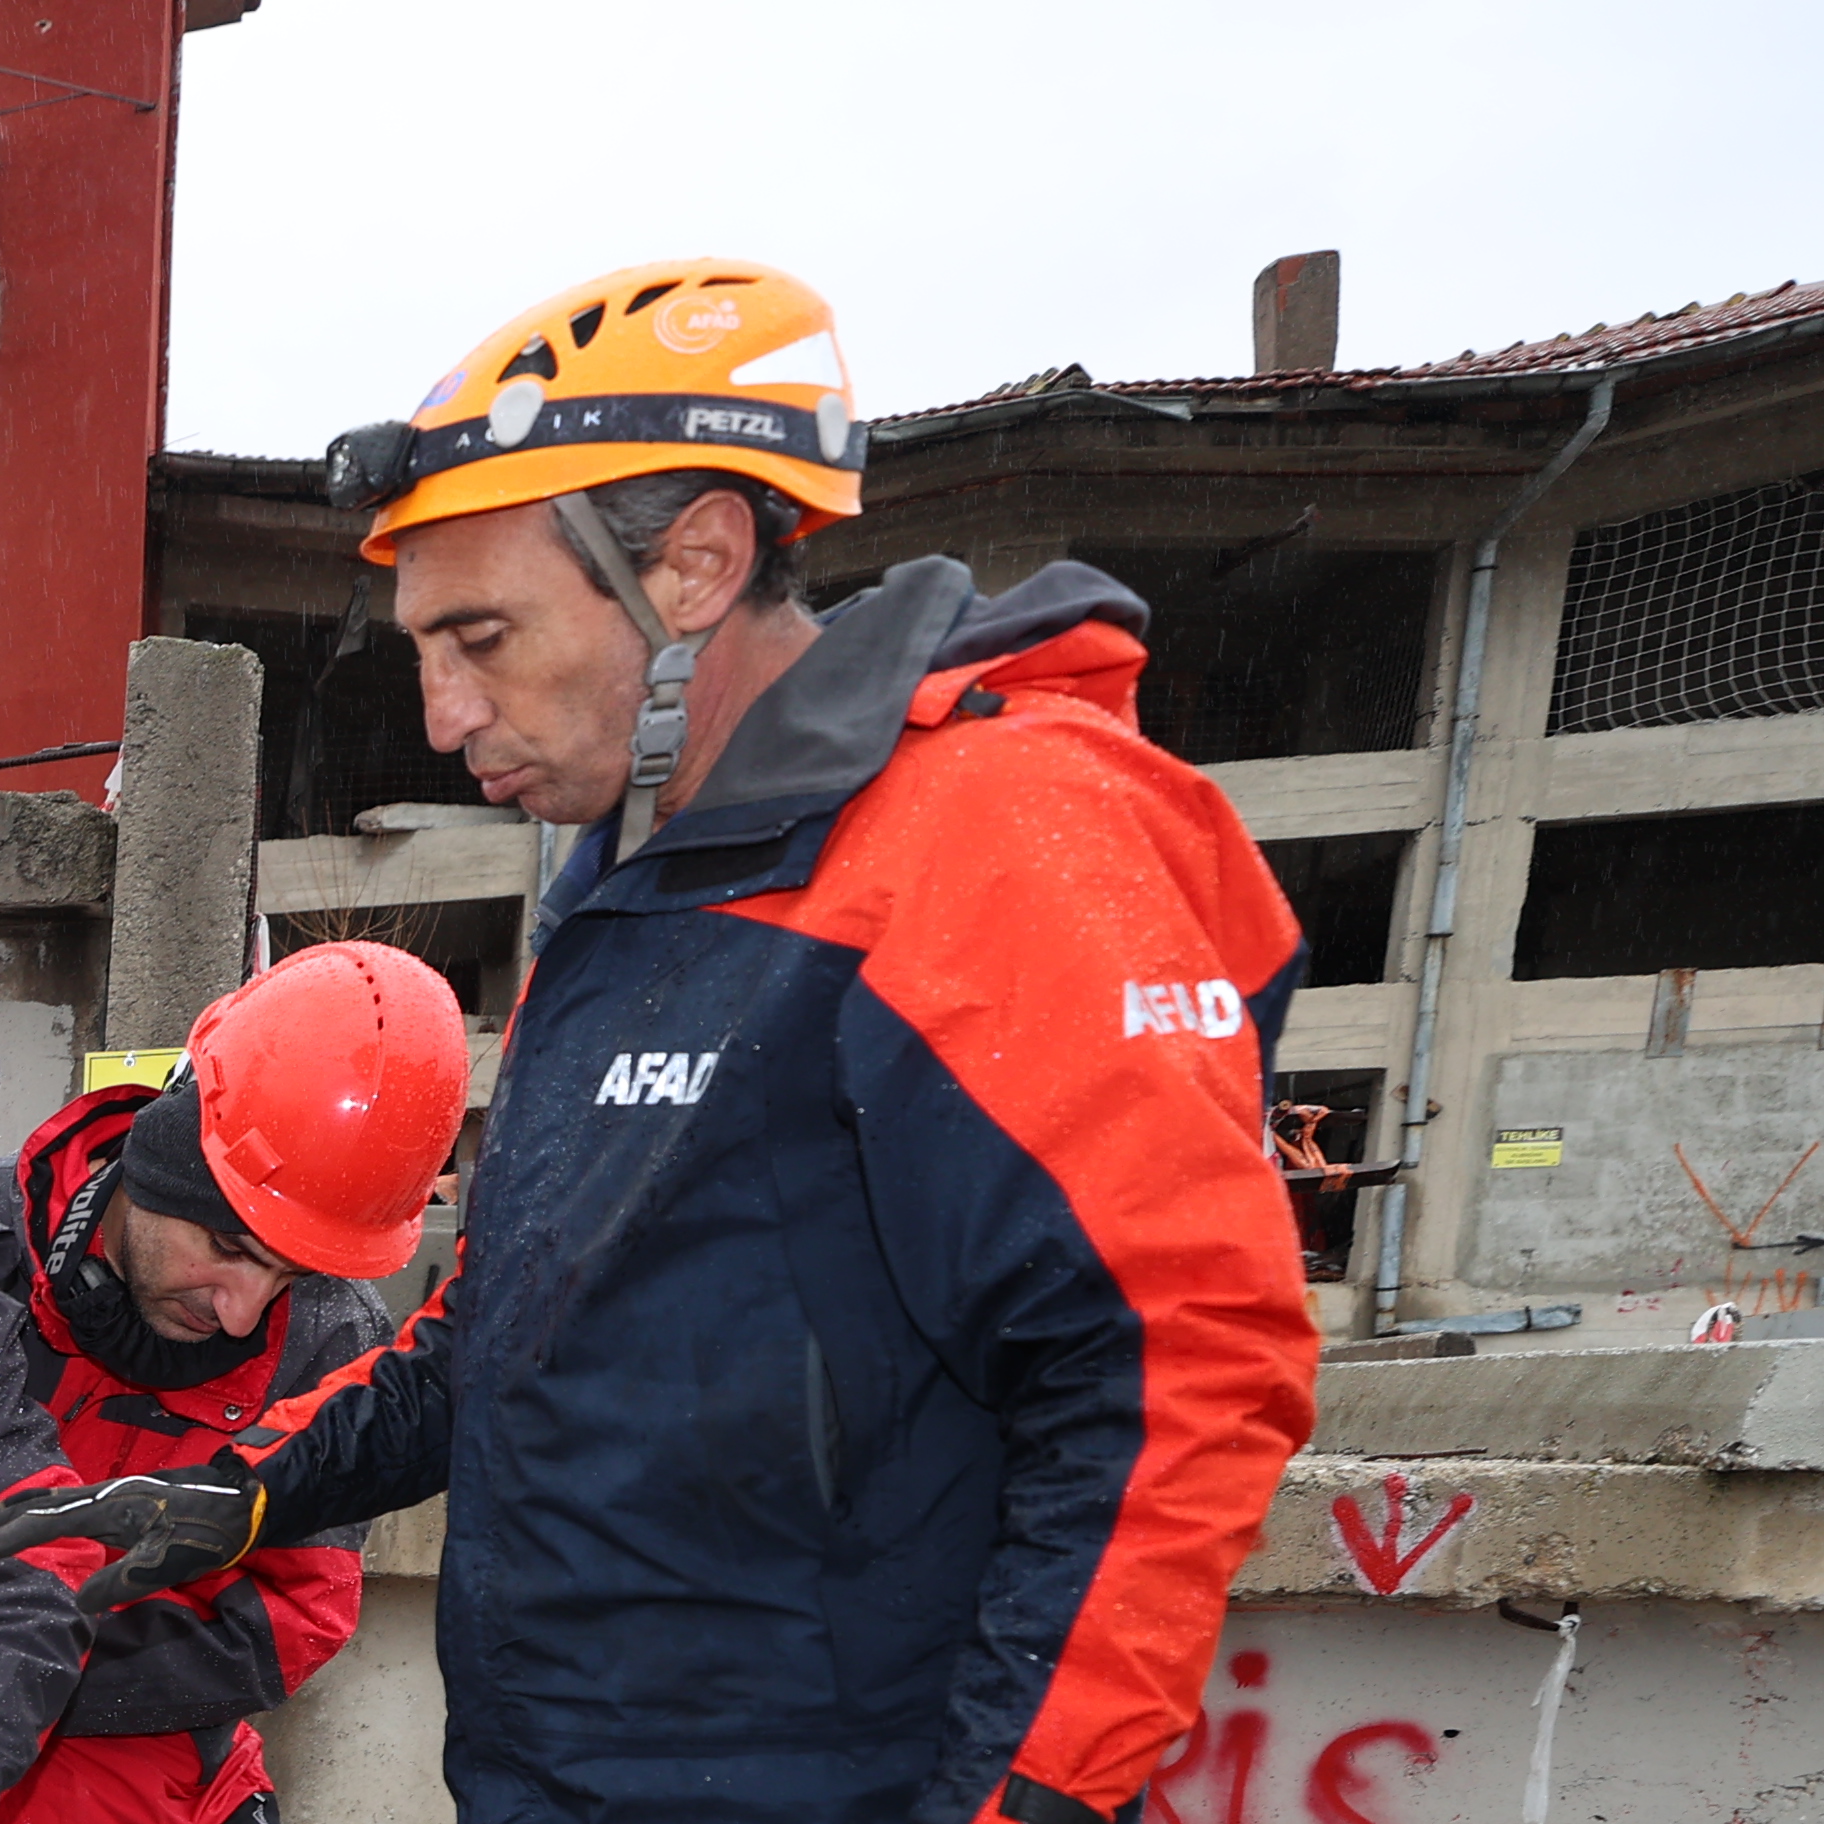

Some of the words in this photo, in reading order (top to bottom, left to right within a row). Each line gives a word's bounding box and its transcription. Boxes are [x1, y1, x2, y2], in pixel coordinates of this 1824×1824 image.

[687, 313, 740, 330] AFAD
[685, 407, 786, 440] PETZL
[594, 1052, 719, 1105] AFAD
